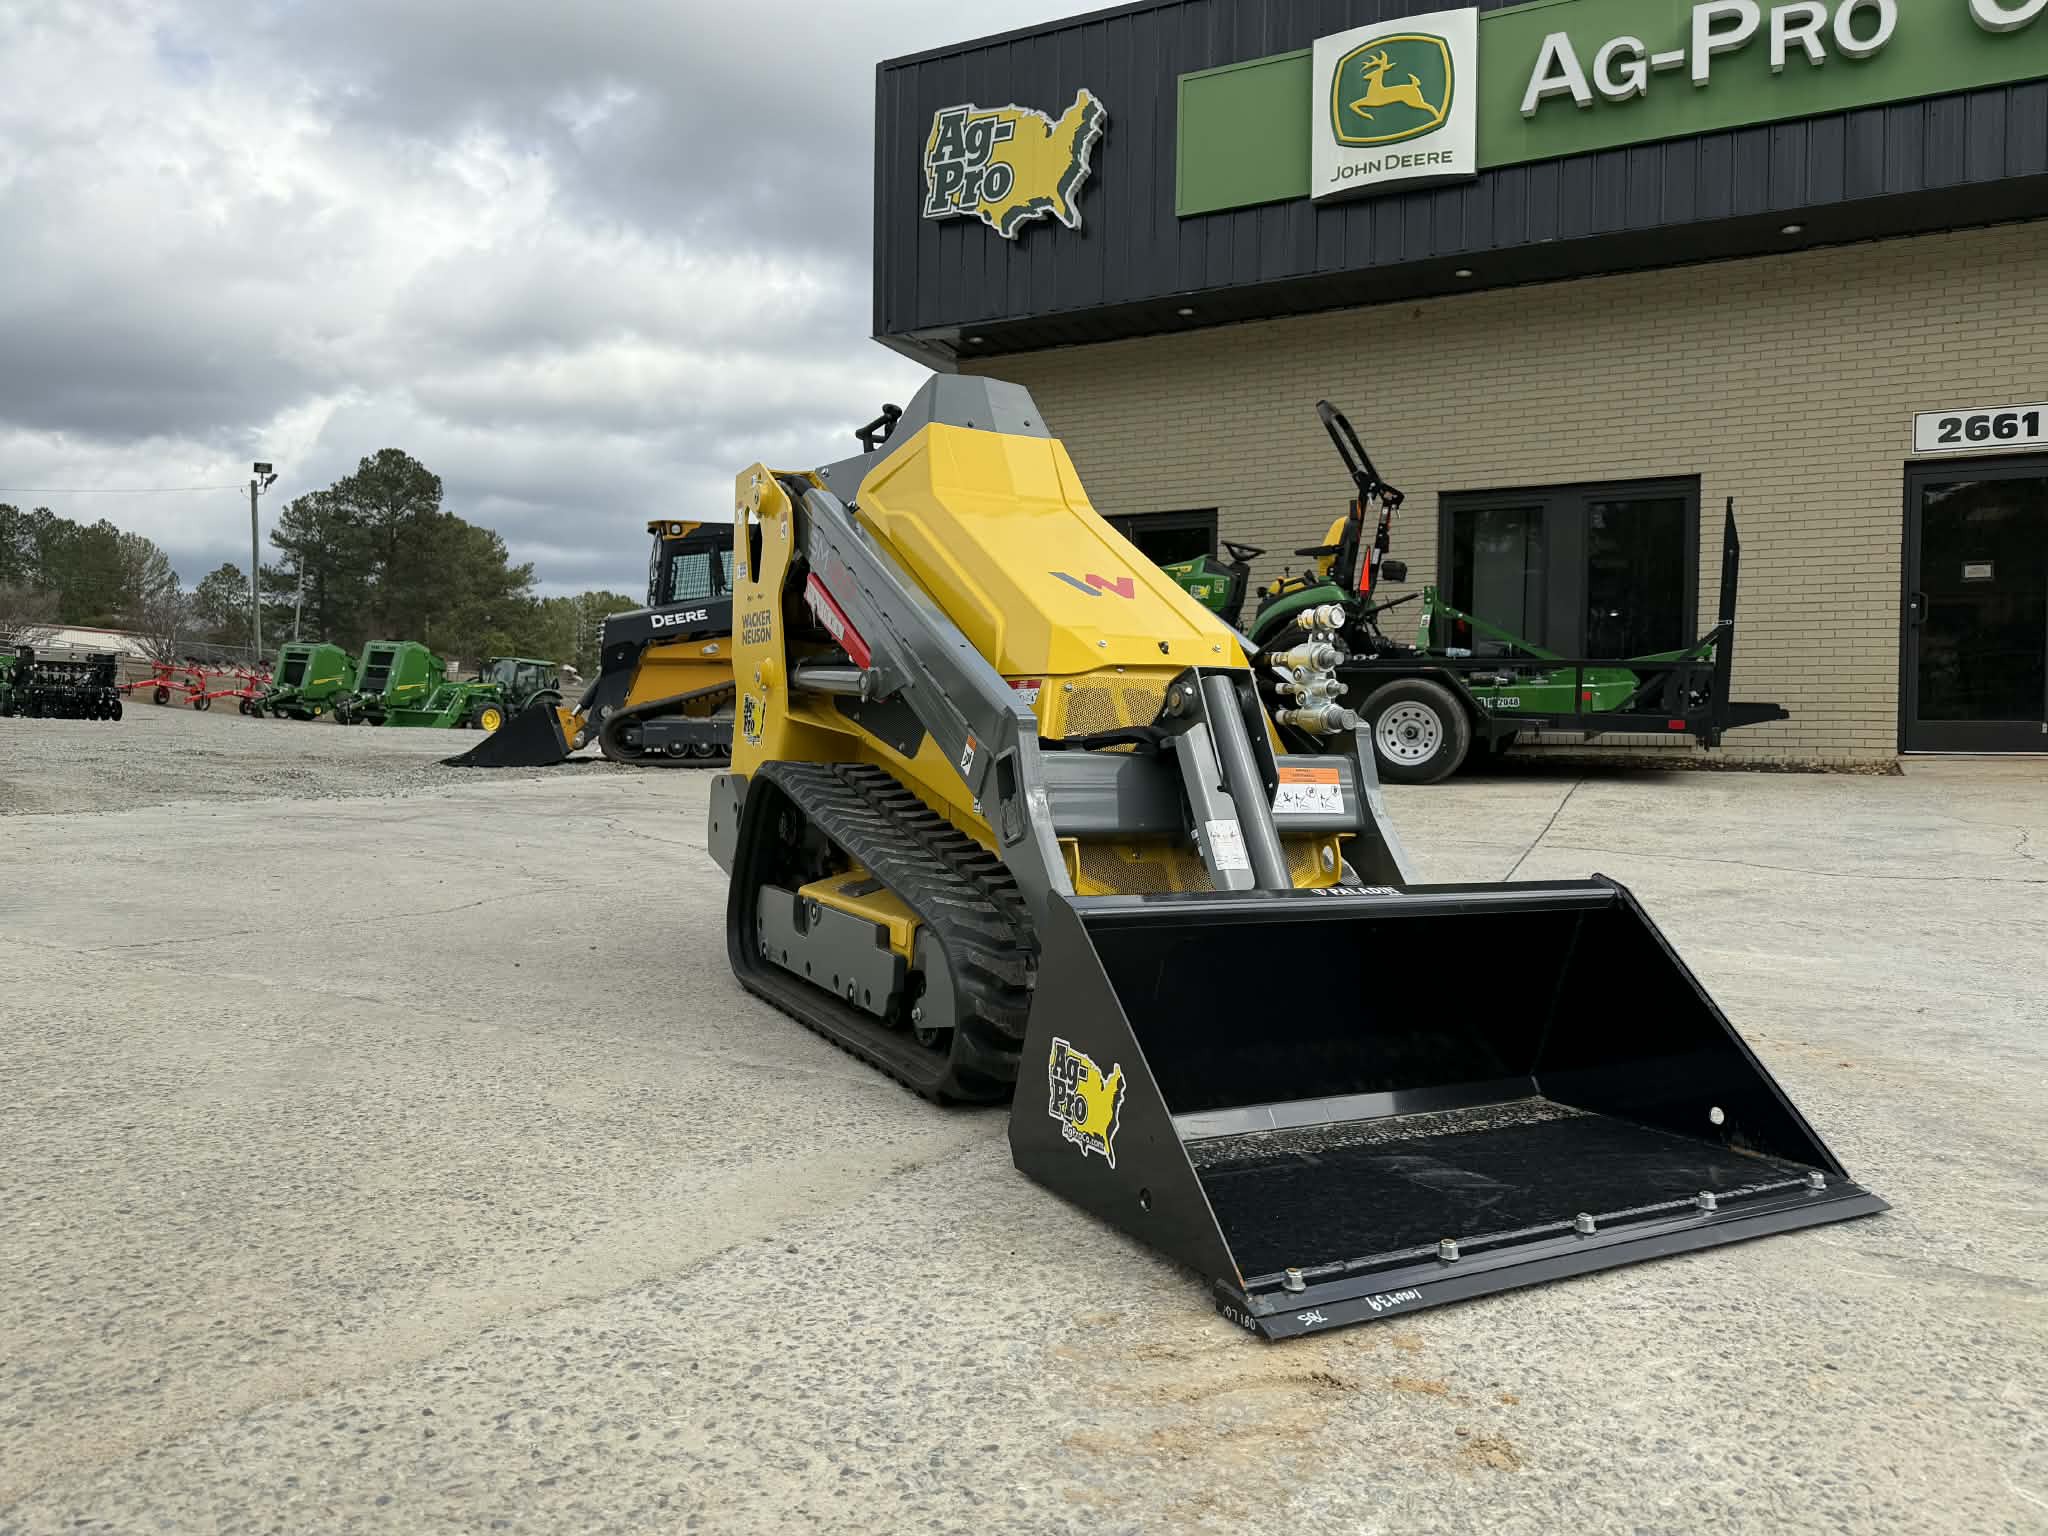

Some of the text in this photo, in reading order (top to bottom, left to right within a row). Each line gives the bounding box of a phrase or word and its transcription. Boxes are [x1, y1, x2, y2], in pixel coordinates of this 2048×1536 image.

[929, 109, 1015, 169] Ag-
[1330, 150, 1453, 182] JOHN DEERE
[928, 160, 1014, 214] Pro
[1937, 411, 2039, 443] 2661
[650, 609, 709, 629] DEERE
[741, 608, 772, 629] WACKER
[741, 626, 772, 646] NEUSON
[1051, 1041, 1088, 1095] Ag-
[1050, 1078, 1088, 1124] Pro
